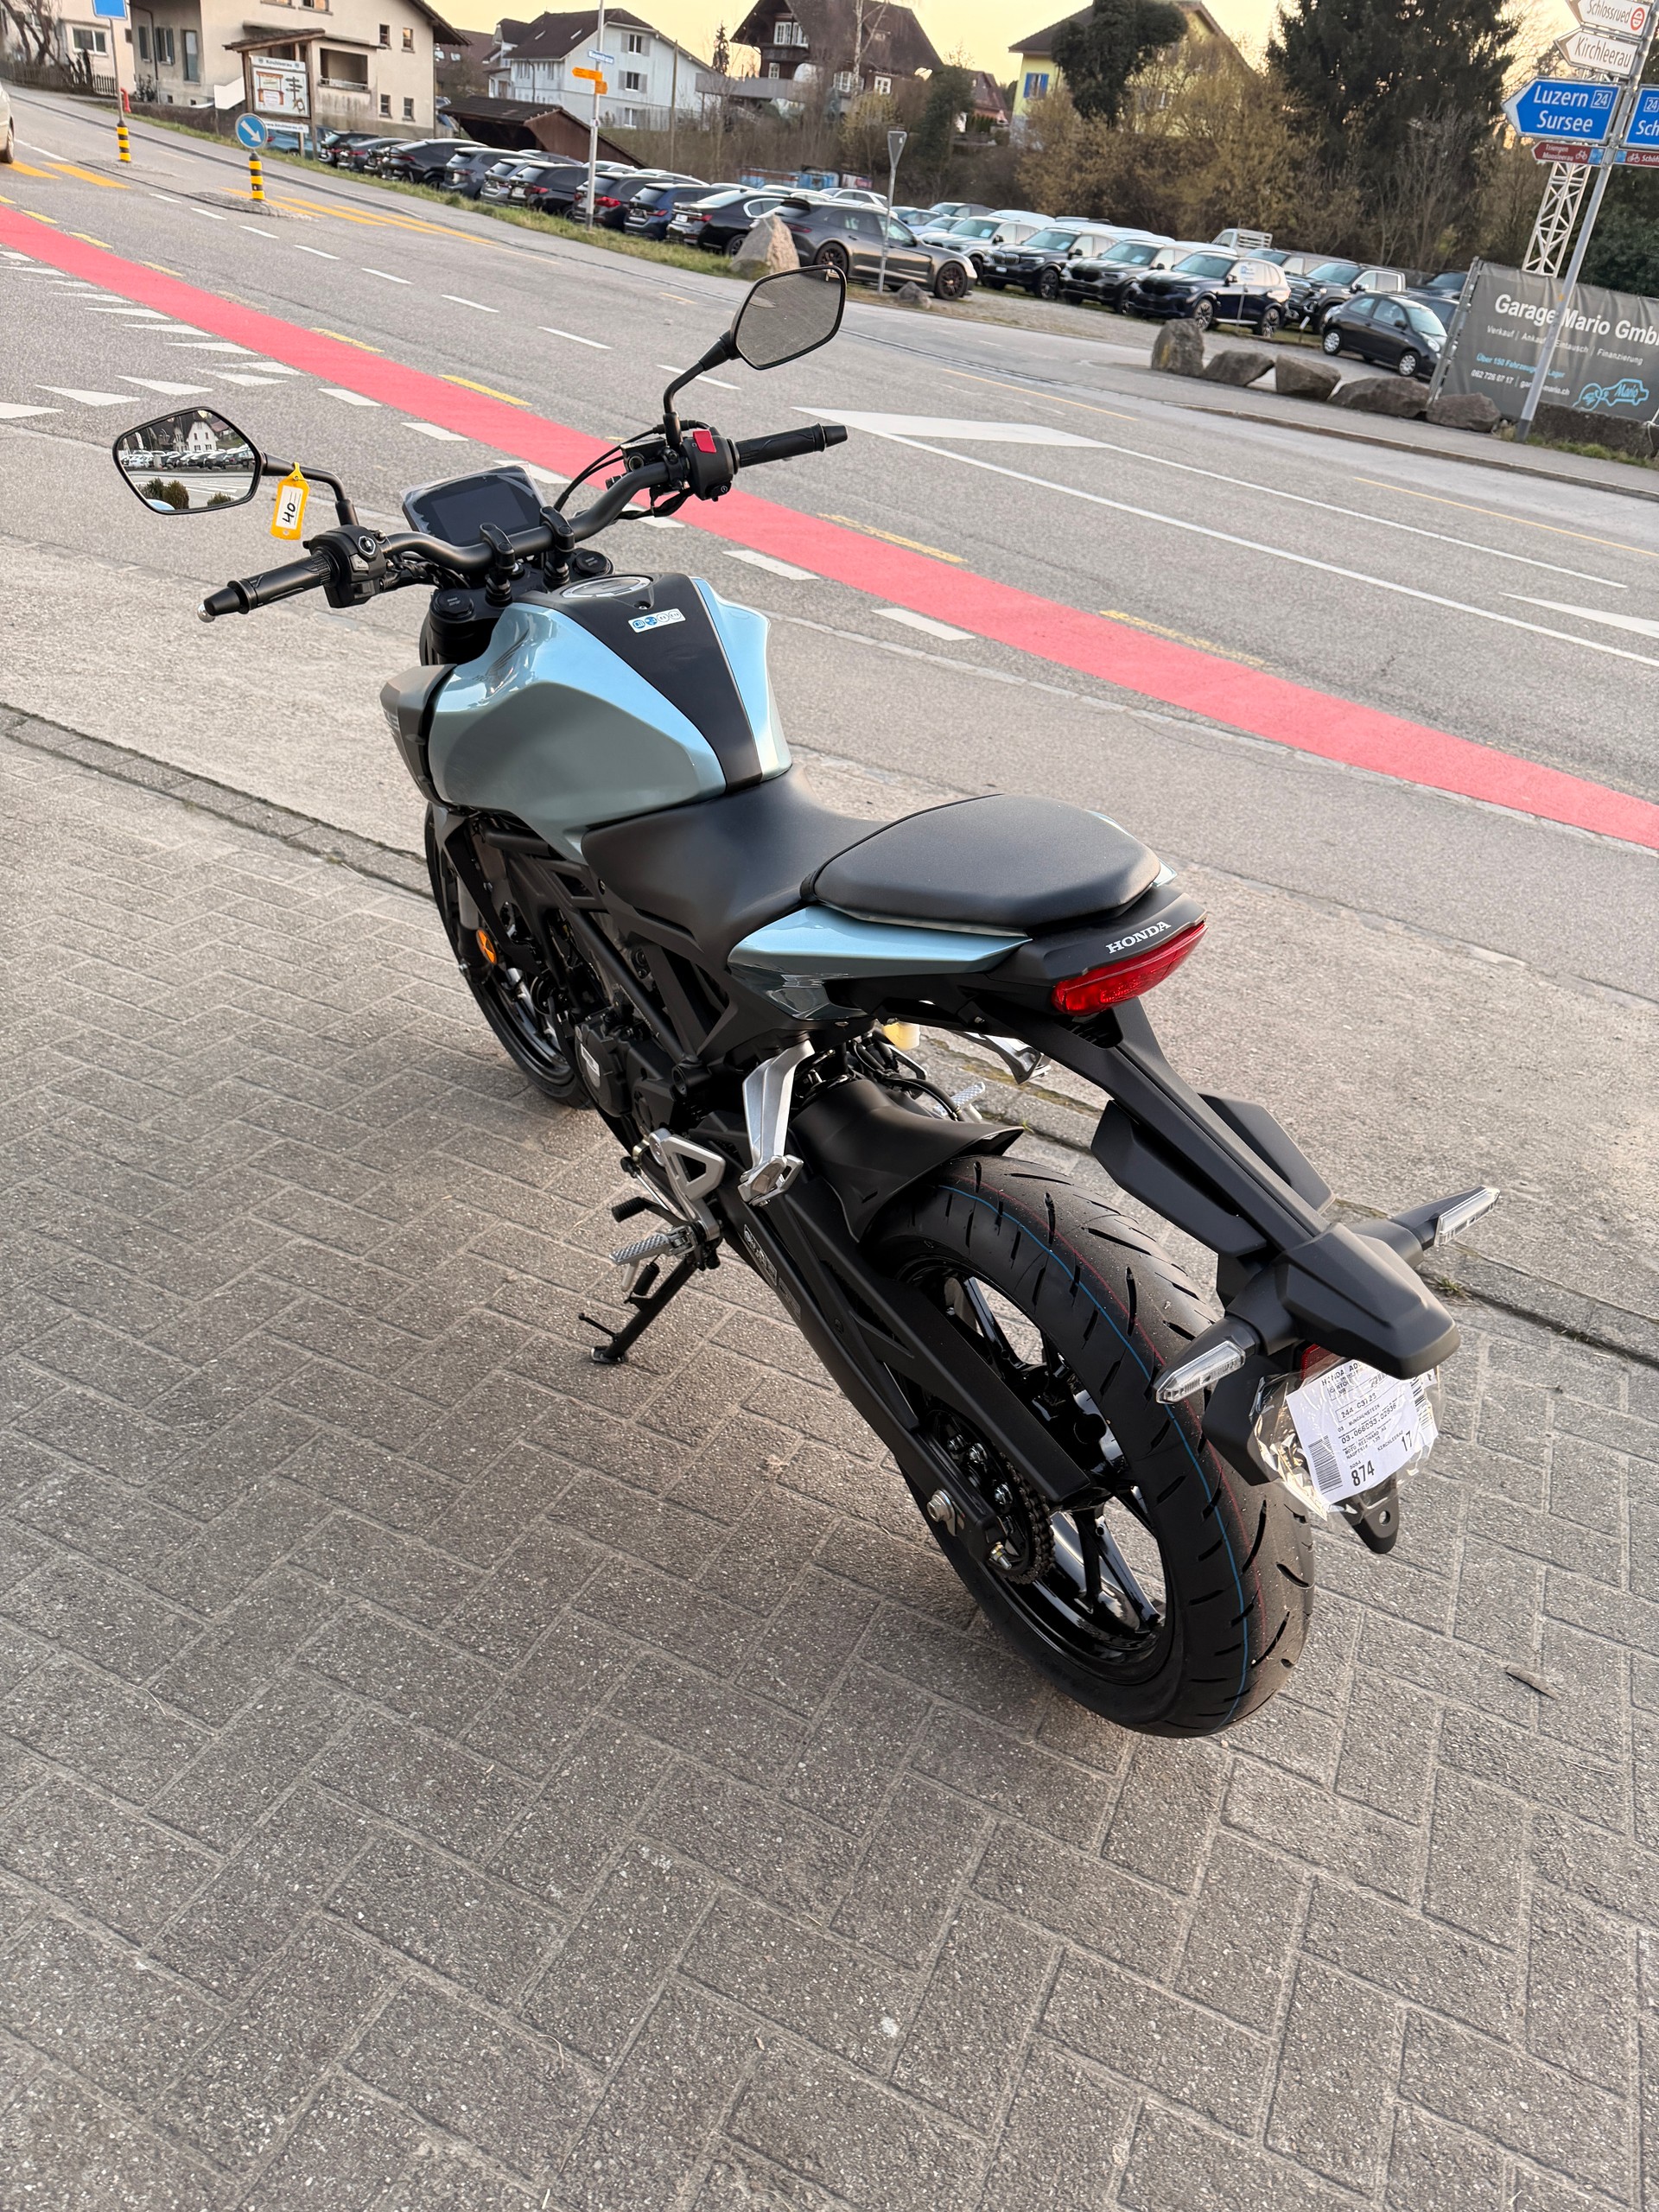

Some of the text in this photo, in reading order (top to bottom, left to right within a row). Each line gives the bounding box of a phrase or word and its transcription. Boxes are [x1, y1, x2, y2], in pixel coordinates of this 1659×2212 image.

[1586, 0, 1632, 24] Schlossrued
[1574, 36, 1632, 68] Kirchleerau
[1534, 86, 1609, 107] Luzern 24
[1646, 99, 1658, 111] 24
[1536, 110, 1593, 132] Sursee
[1495, 294, 1659, 346] Garage Mario Gmb
[1487, 325, 1516, 338] Verkauf
[1522, 332, 1547, 345] Ankauf
[1597, 348, 1643, 365] Finanzierung
[1106, 921, 1172, 954] HONDA
[1402, 1431, 1411, 1451] 17
[1351, 1460, 1375, 1486] 874
